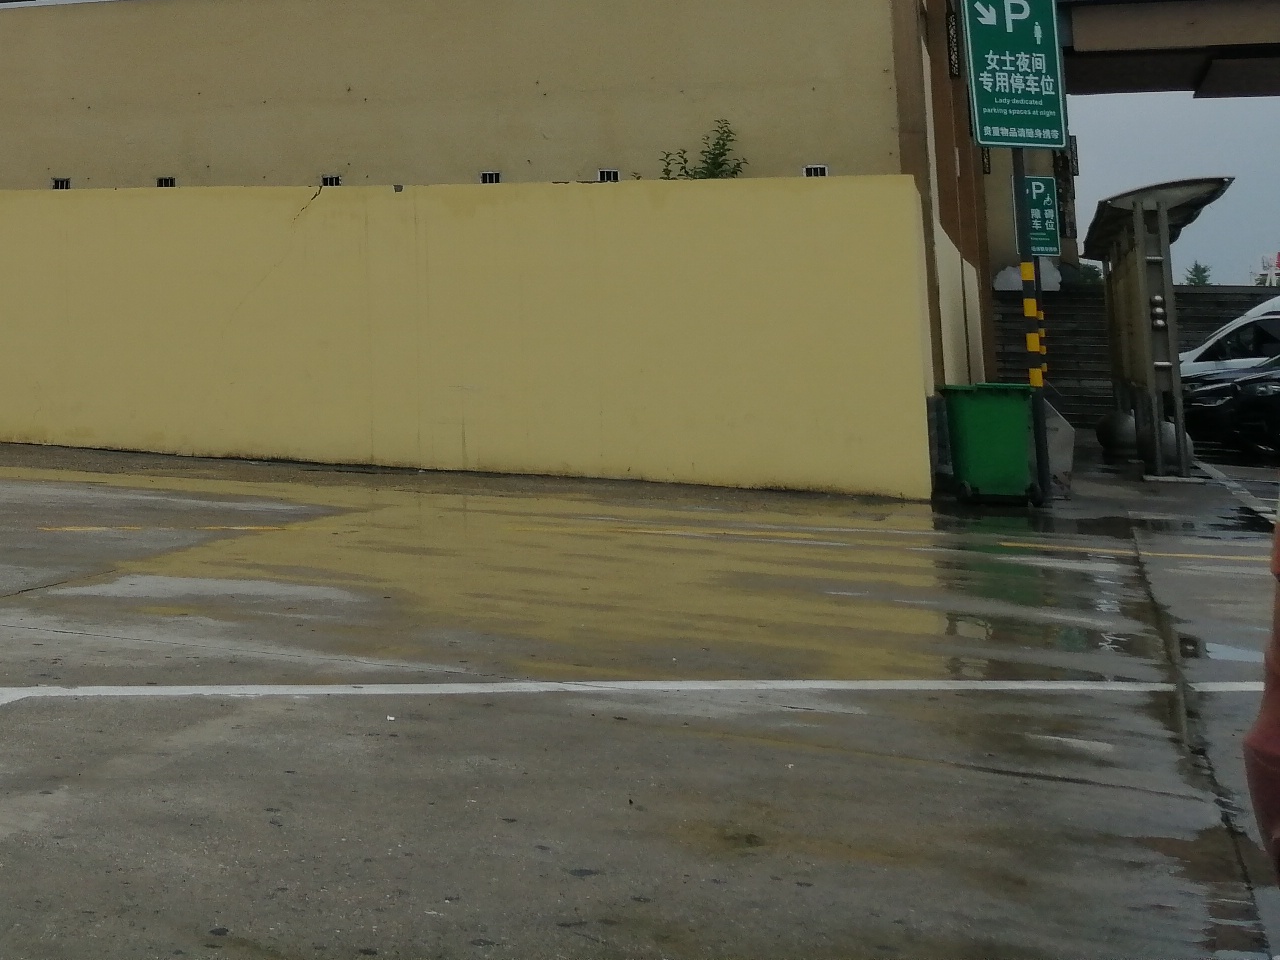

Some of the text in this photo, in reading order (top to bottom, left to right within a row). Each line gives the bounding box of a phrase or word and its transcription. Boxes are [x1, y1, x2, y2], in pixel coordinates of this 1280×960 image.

[984, 49, 1046, 74] 女士夜间
[978, 71, 1056, 95] 专用停车位
[983, 107, 1008, 115] parking
[1039, 110, 1056, 118] night
[1031, 181, 1045, 200] P
